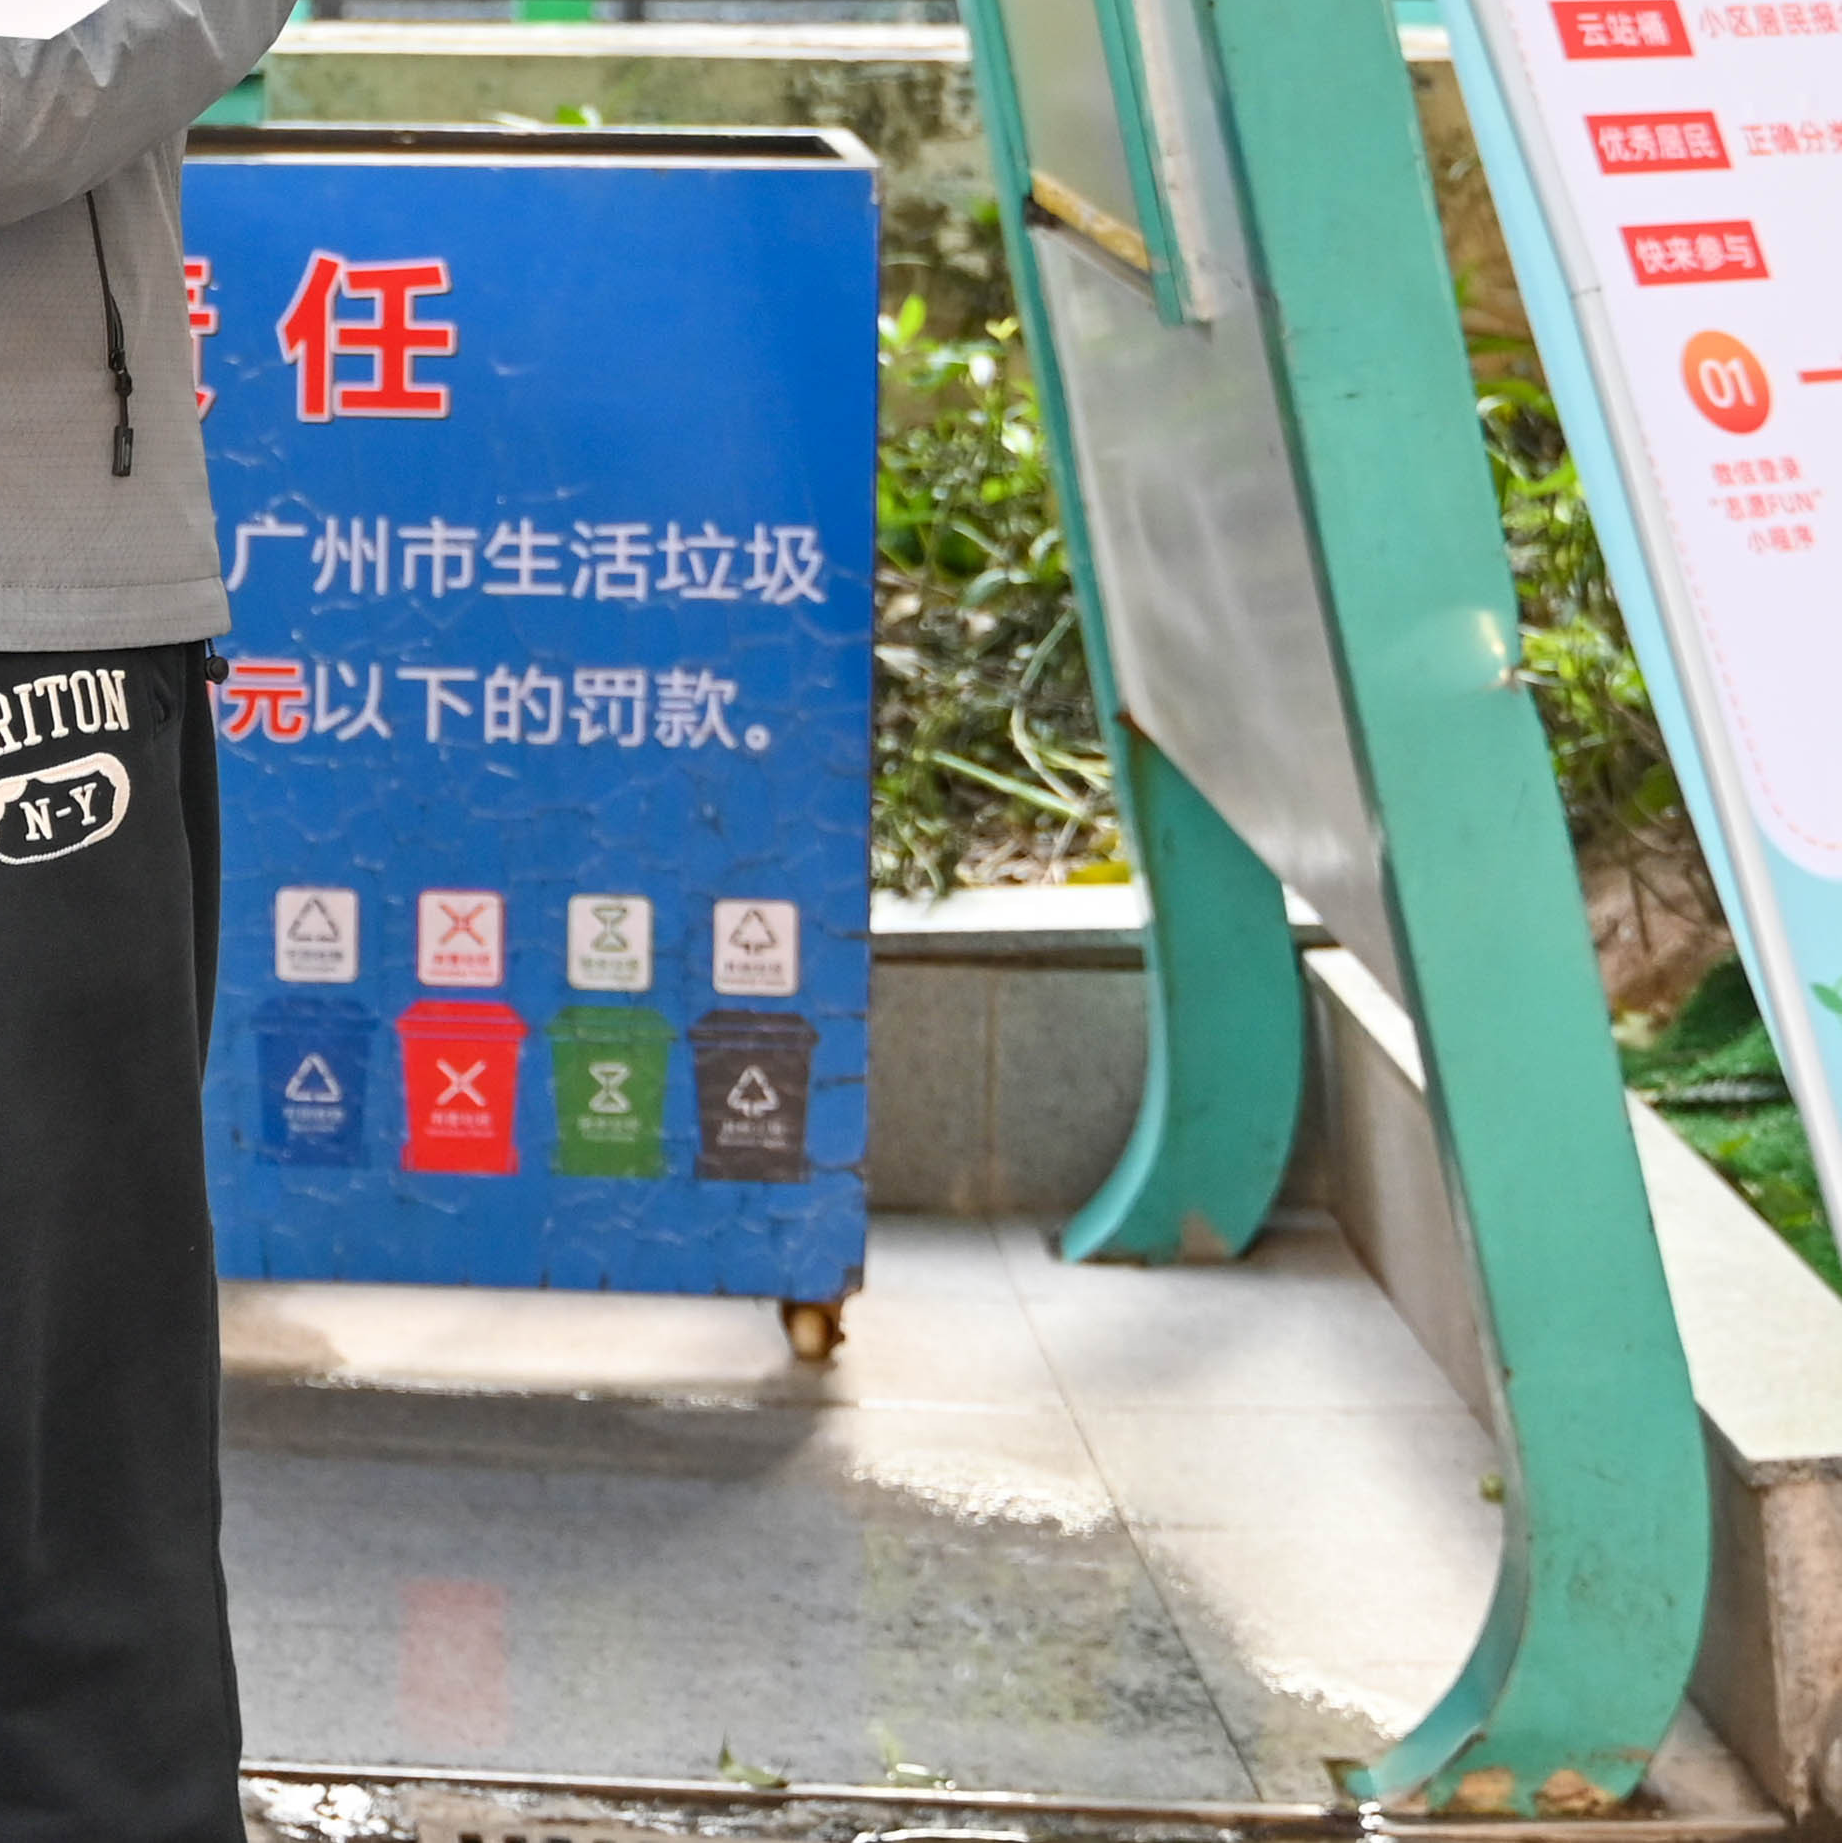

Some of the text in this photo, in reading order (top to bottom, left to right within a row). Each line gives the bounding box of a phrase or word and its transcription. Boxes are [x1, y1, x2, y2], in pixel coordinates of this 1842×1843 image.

[1575, 9, 1673, 48] 云站桶
[1598, 121, 1720, 164] 优秀居民
[1634, 232, 1757, 274] 快来参与
[1698, 357, 1756, 411] 01
[225, 515, 827, 605] 广州市生活垃圾
[18, 781, 98, 842] N-Y
